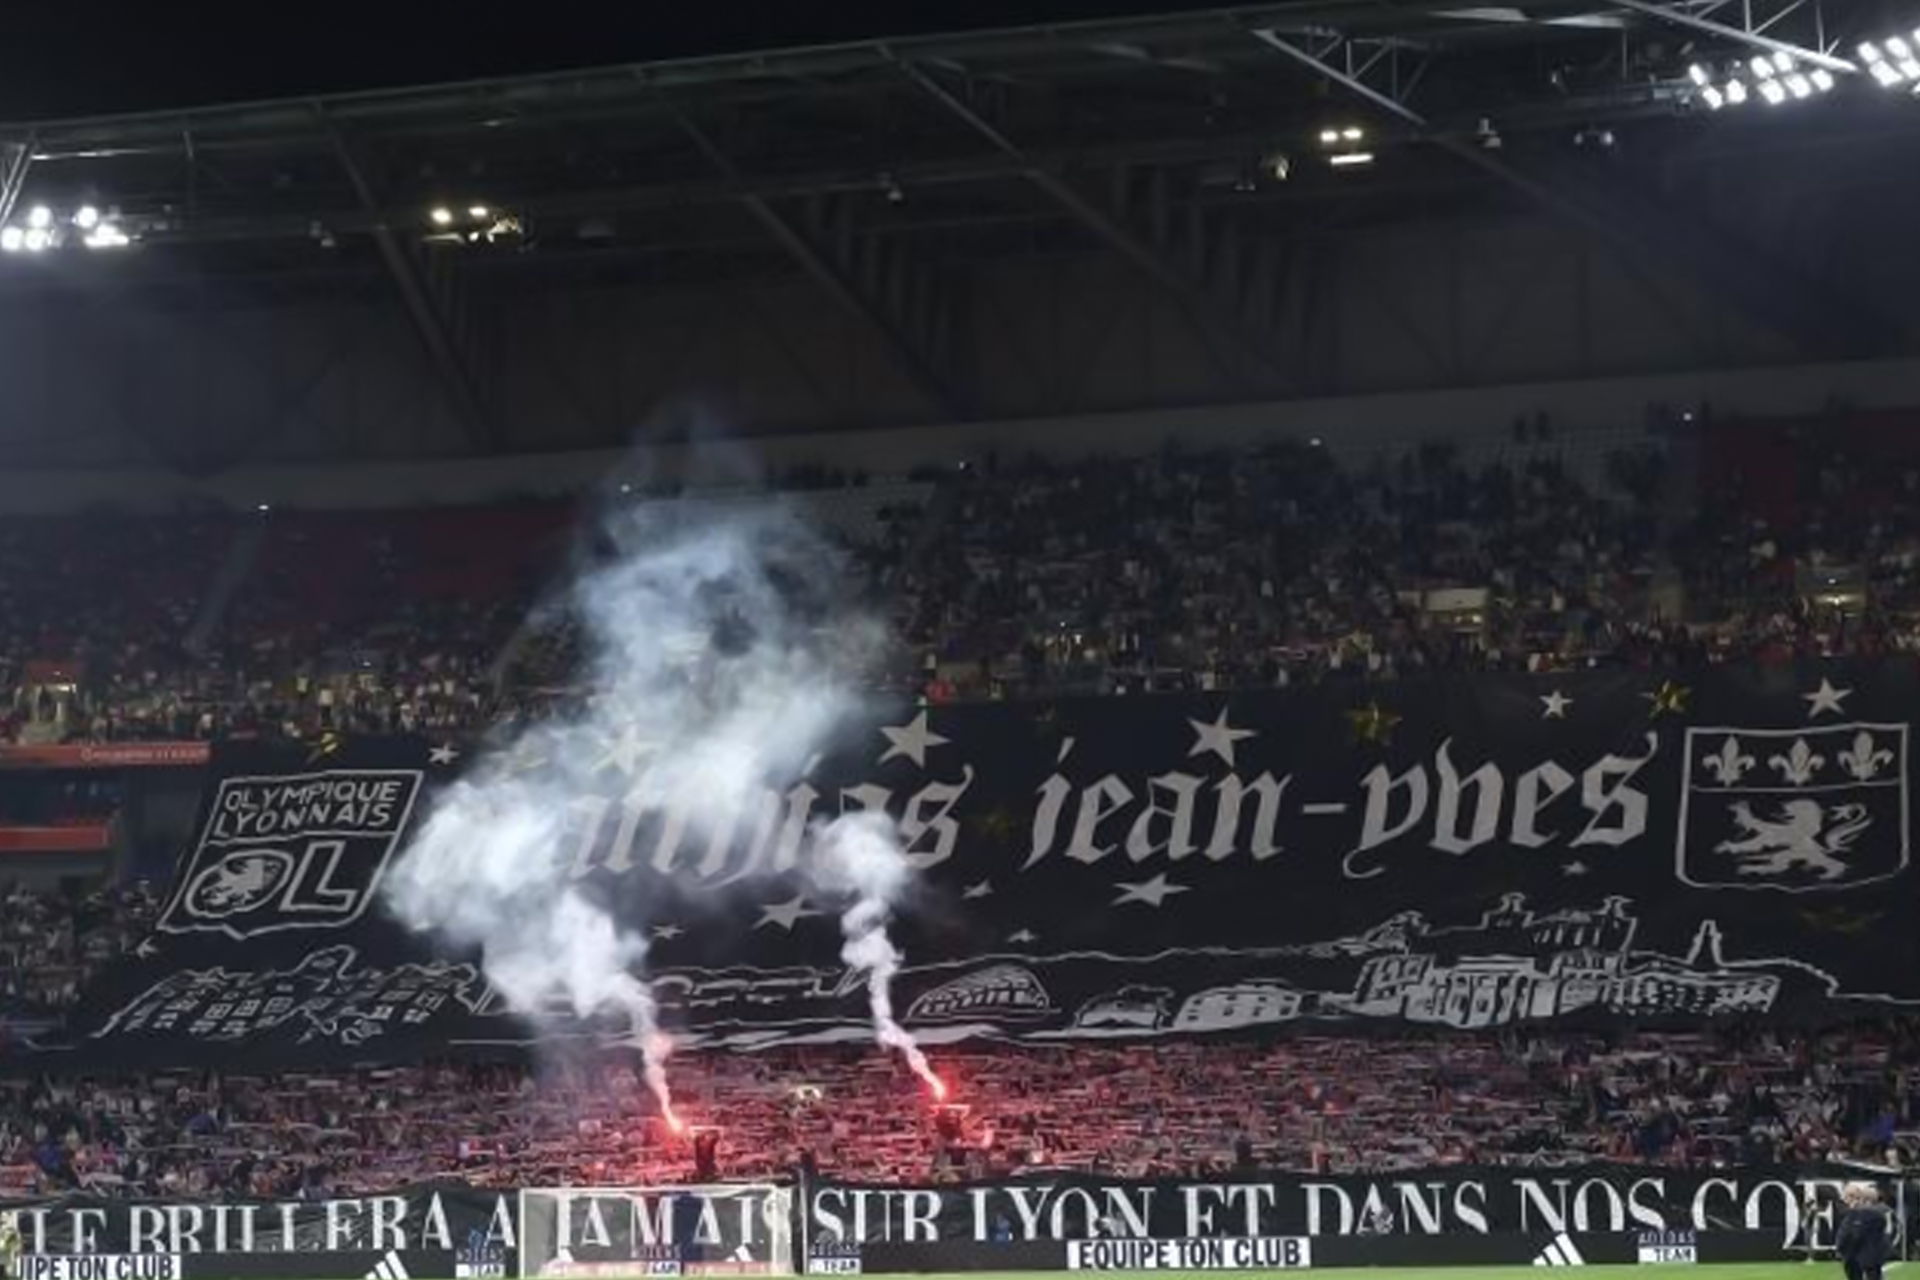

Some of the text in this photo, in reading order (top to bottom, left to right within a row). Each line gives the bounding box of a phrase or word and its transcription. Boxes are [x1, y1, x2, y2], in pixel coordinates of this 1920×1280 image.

[224, 781, 401, 814] OLYMPIQUE
[214, 803, 391, 838] LYONNAIS
[482, 1194, 516, 1248] A
[812, 1187, 942, 1243] SUR
[966, 1186, 1156, 1241] LYON
[1178, 1183, 1276, 1237] ET
[1300, 1180, 1488, 1236] DANS
[1511, 1177, 1666, 1233] NOS
[66, 1255, 108, 1279] TON
[116, 1254, 173, 1279] CLUB
[1080, 1238, 1301, 1269] EQUIPE TON CLUB
